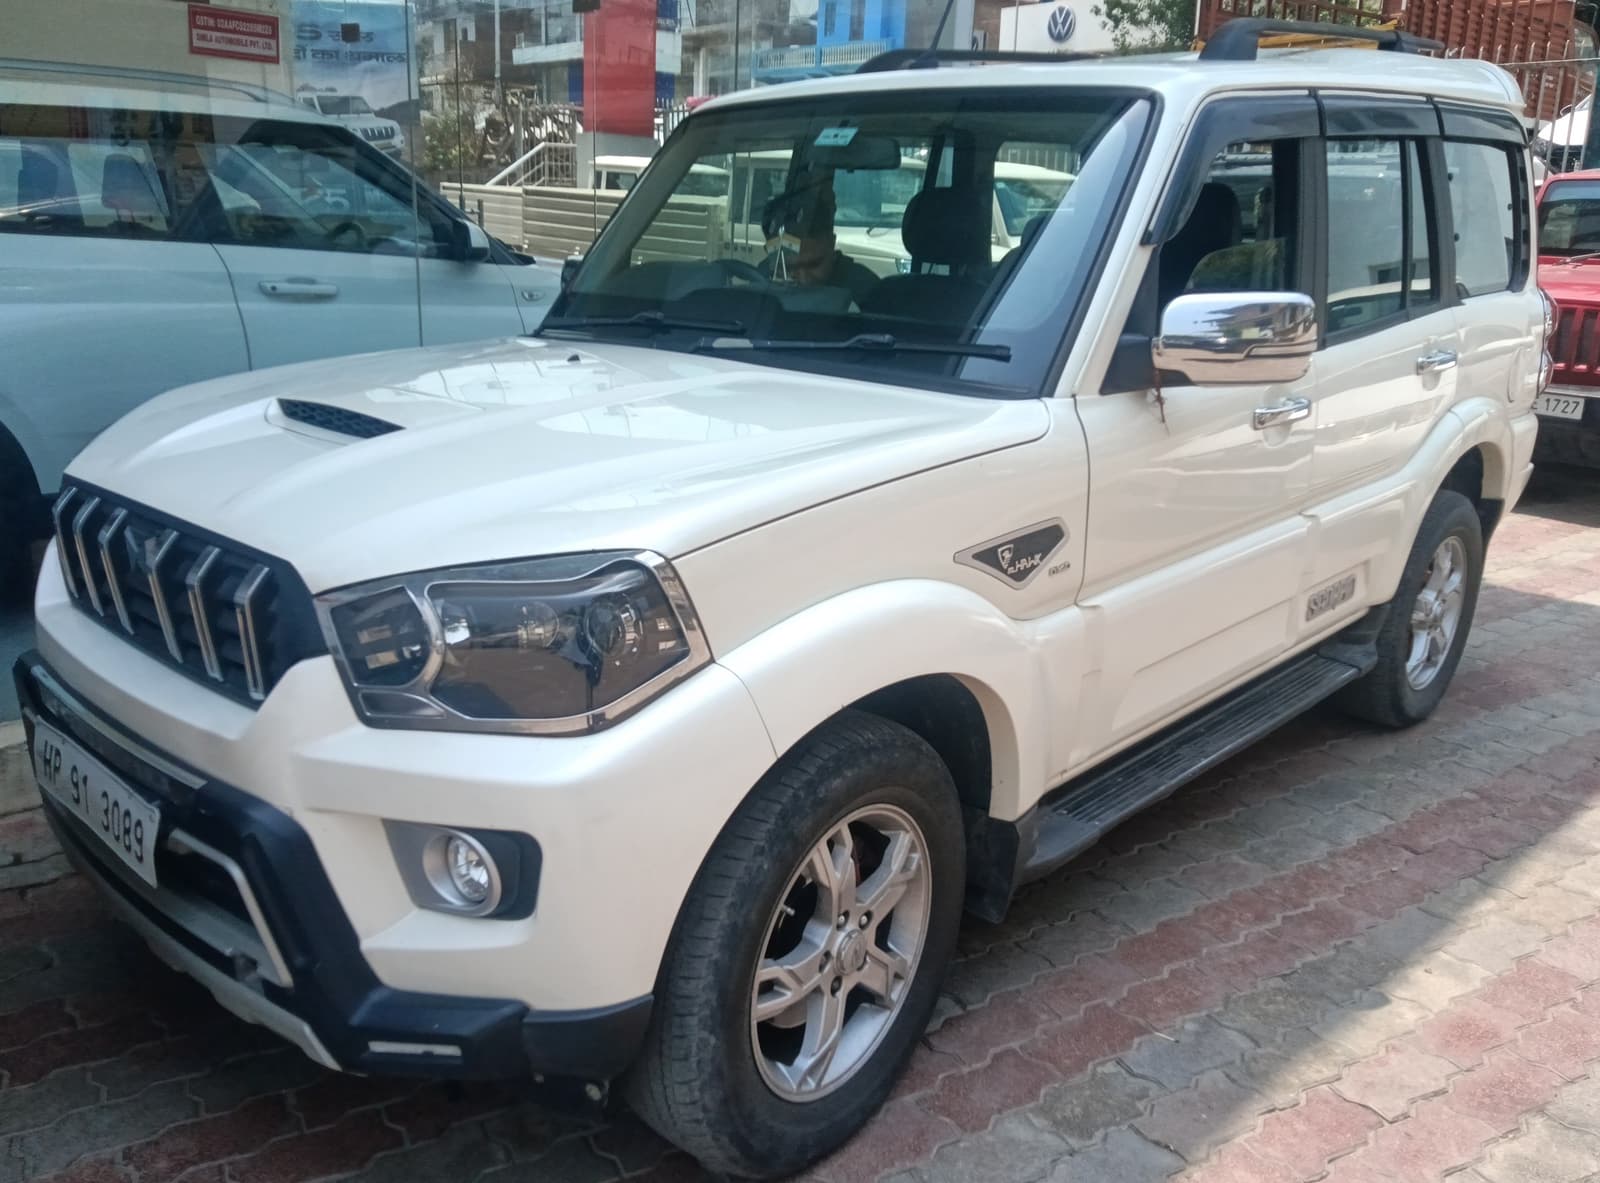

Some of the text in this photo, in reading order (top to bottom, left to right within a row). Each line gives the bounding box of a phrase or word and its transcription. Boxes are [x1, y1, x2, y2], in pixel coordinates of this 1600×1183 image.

[1545, 398, 1580, 414] 1727
[43, 739, 144, 864] HP 91 3089
